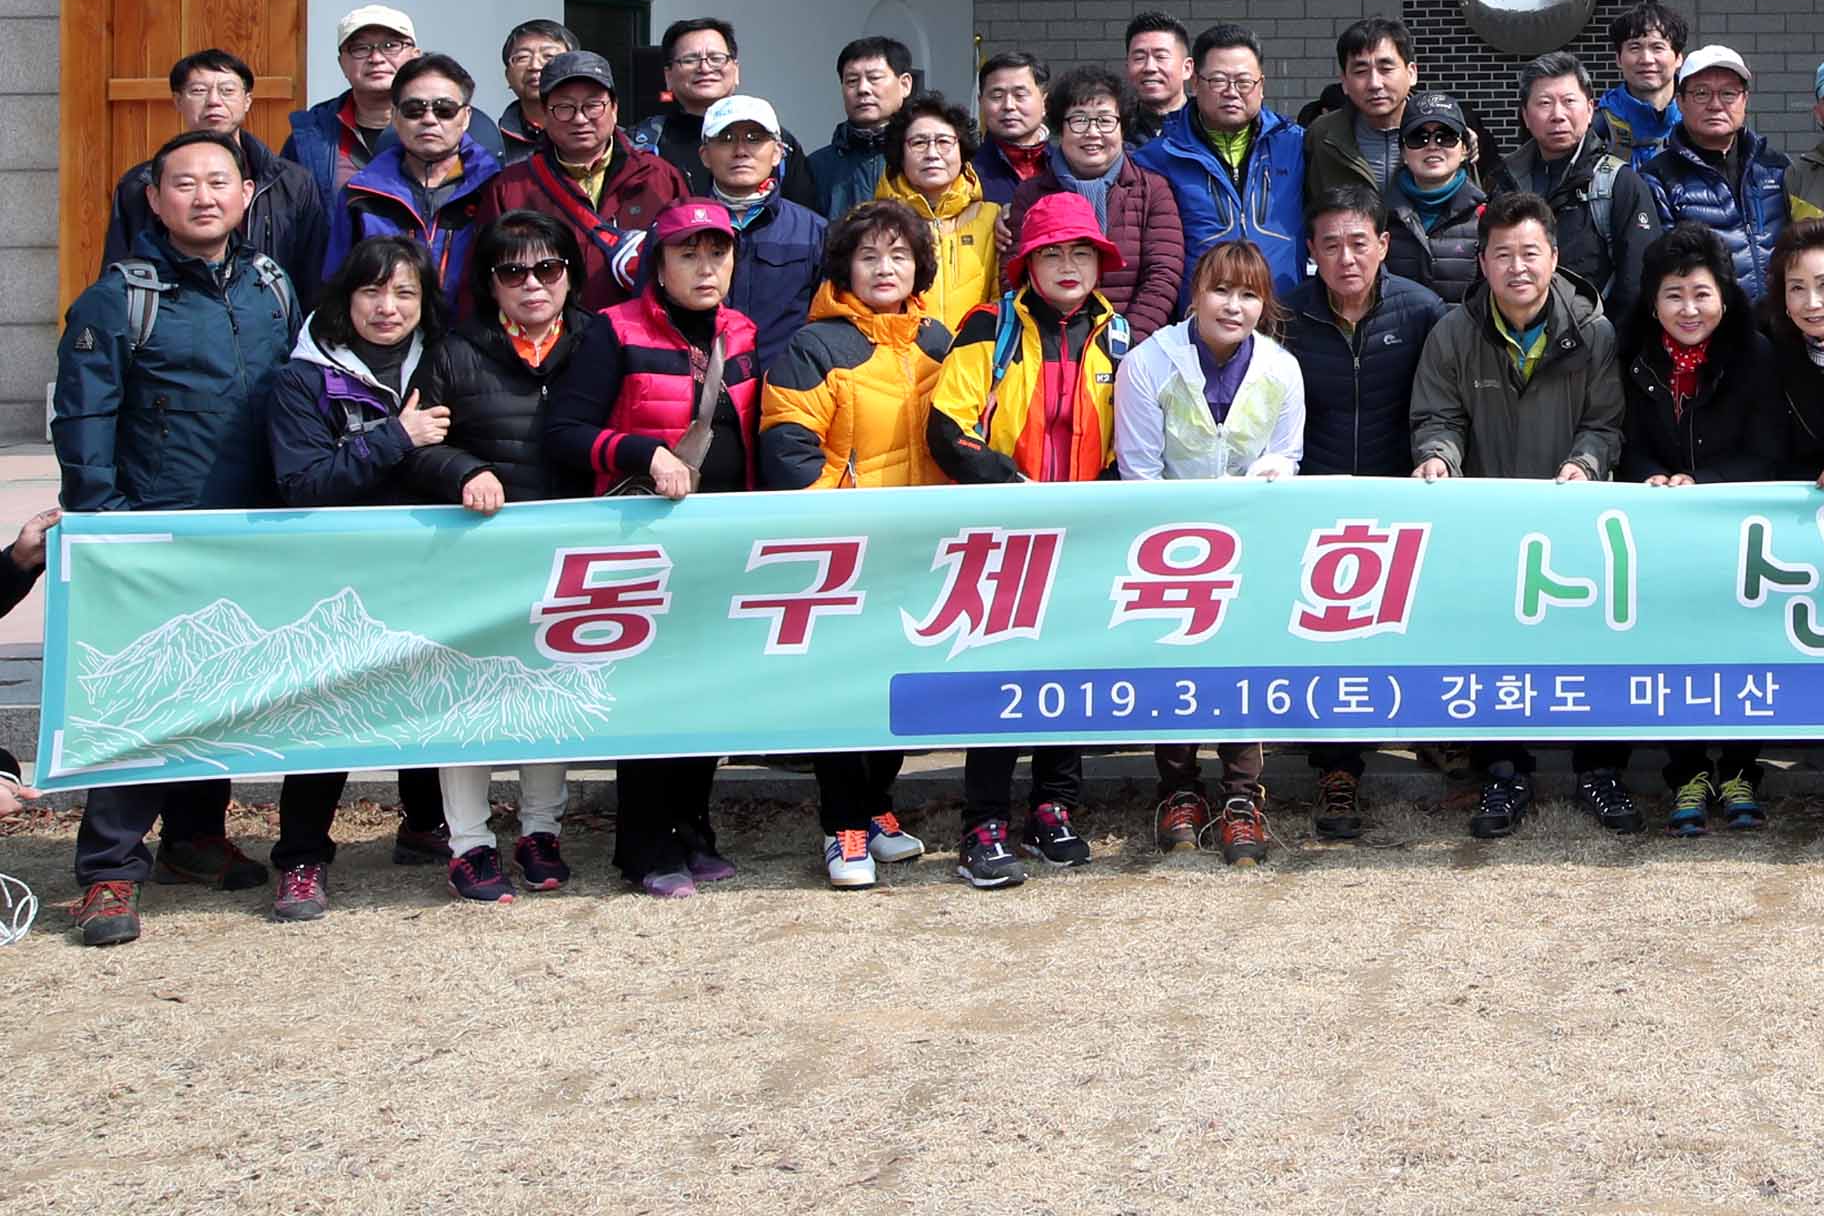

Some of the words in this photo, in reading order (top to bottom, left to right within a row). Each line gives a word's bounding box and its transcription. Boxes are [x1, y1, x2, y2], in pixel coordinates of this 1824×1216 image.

[1000, 676, 1402, 720] 2019.3.16(토)
[1441, 674, 1592, 719] 강화도
[1630, 673, 1780, 718] 마니산
